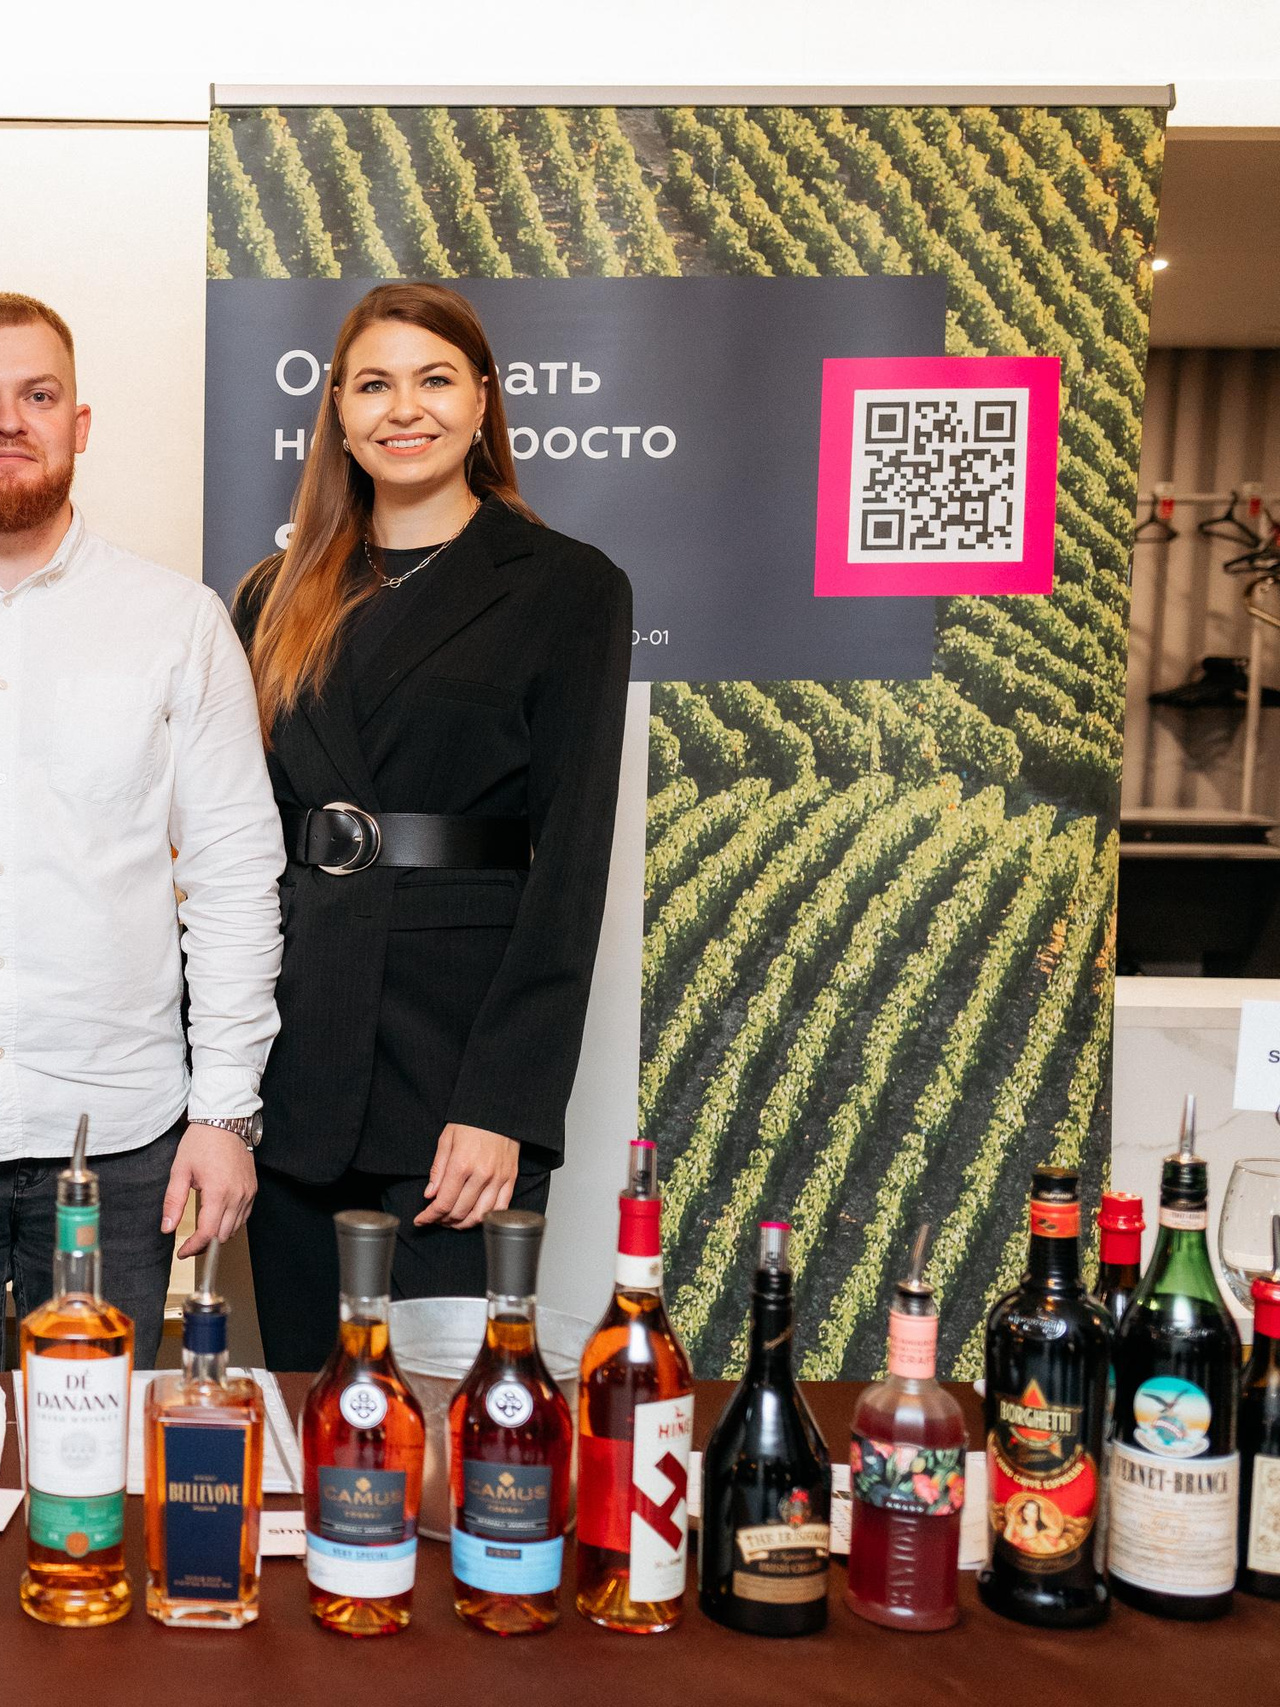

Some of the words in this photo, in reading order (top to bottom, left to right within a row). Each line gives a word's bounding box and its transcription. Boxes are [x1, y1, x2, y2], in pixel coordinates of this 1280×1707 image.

[36, 1392, 120, 1413] DANANN
[999, 1400, 1072, 1433] BORGHETTI
[168, 1481, 239, 1506] BELLEVOYE
[323, 1484, 402, 1507] CAMUS
[467, 1479, 547, 1501] CAMUS
[743, 1533, 774, 1548] THE
